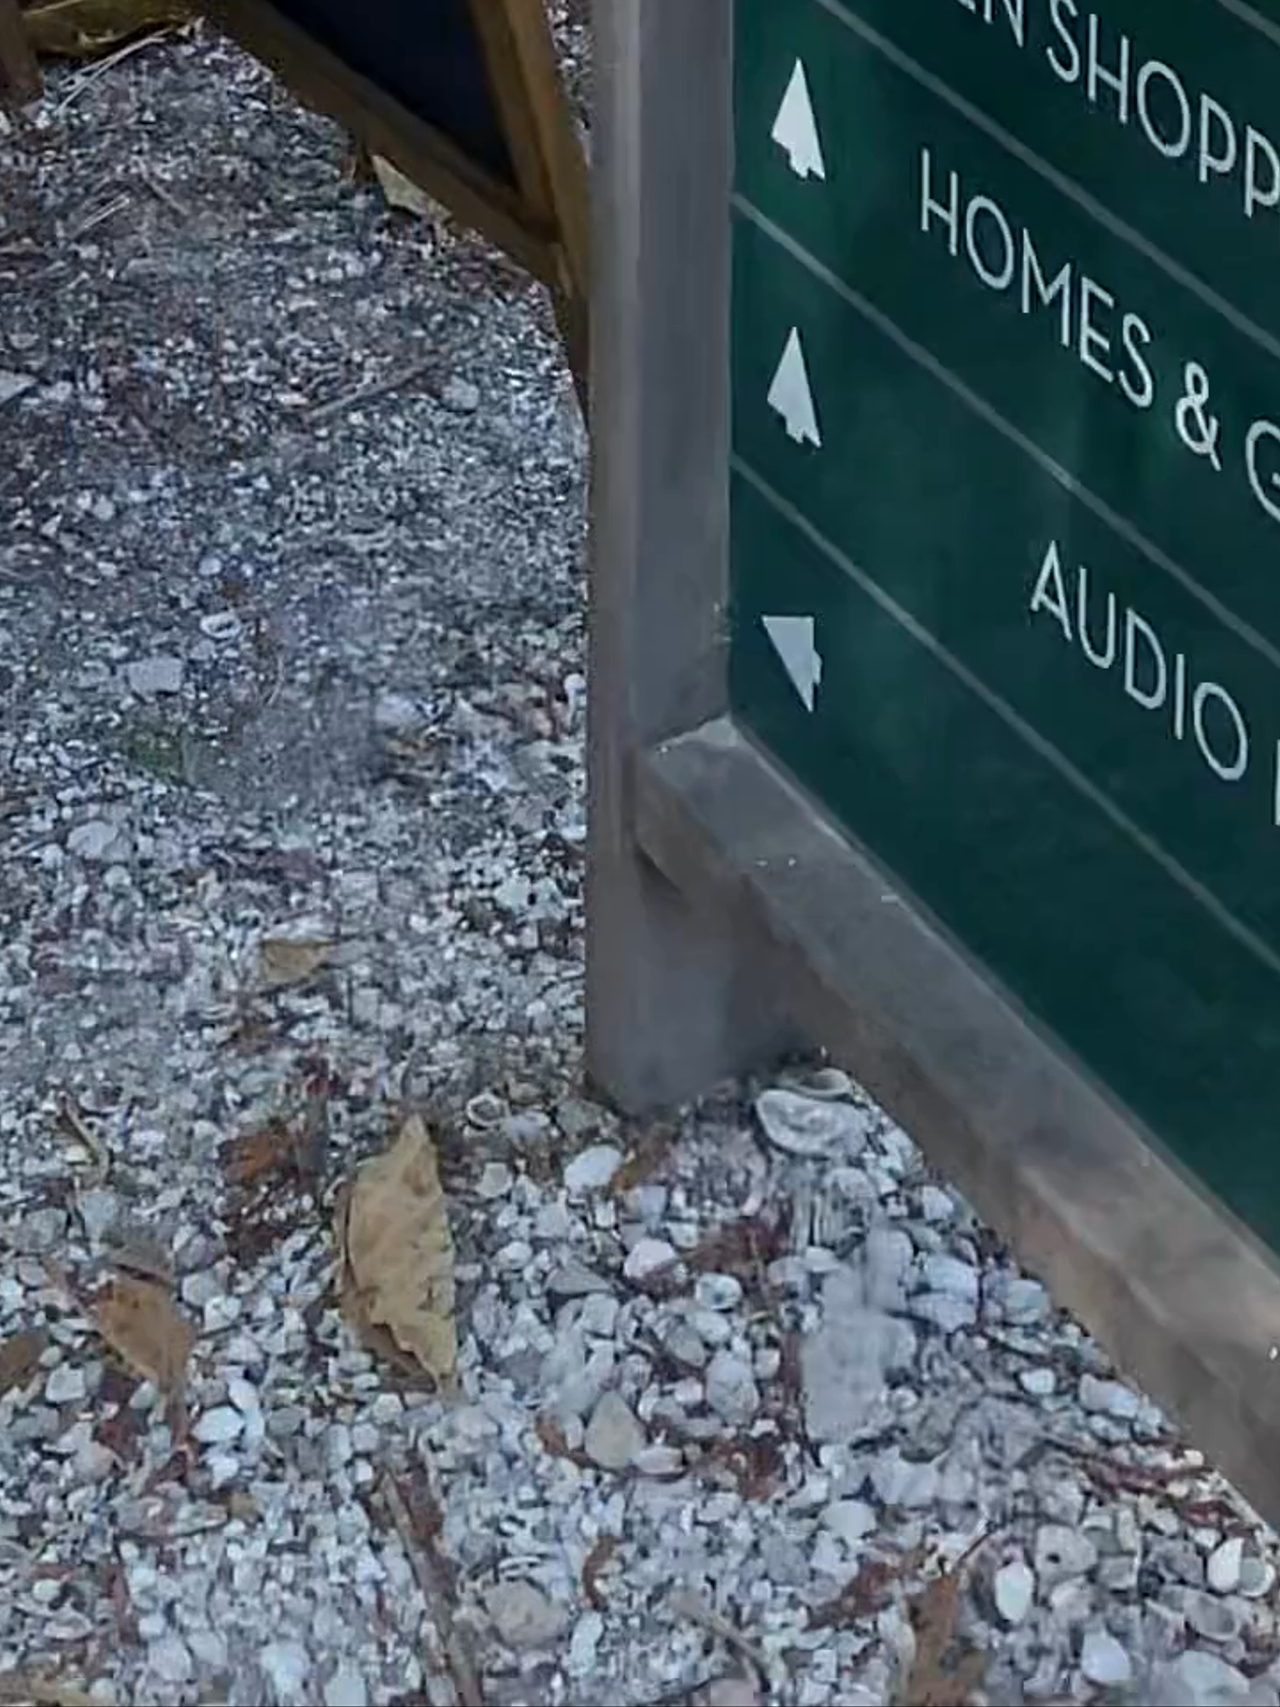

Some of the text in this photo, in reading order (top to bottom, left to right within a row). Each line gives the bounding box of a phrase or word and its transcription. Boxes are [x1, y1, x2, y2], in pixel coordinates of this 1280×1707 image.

[920, 146, 1154, 410] HOMES
[1174, 360, 1223, 472] &
[1028, 538, 1250, 782] AUDIO
